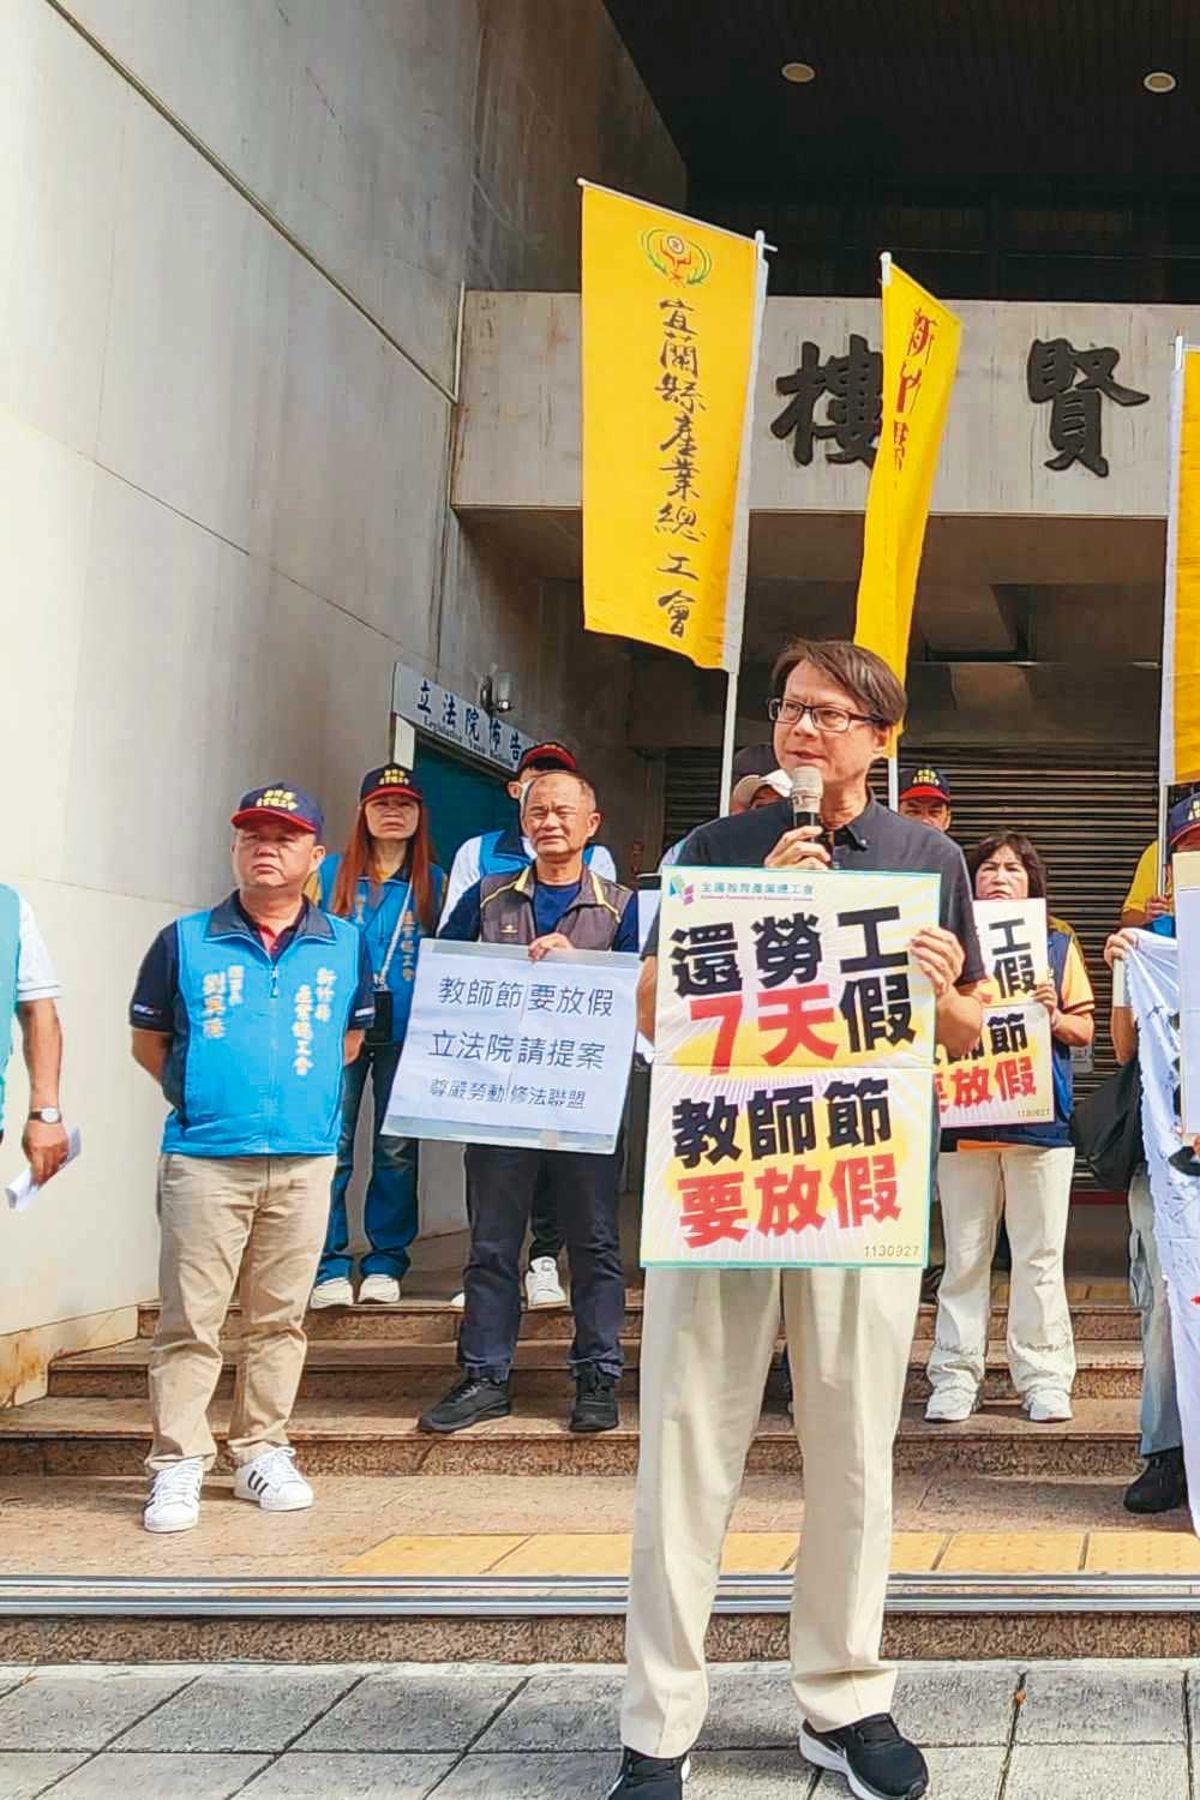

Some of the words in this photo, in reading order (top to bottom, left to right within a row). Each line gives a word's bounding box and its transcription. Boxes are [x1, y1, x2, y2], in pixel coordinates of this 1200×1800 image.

[438, 977, 614, 1017] 教師節要放假
[669, 906, 909, 998] 還勞工
[429, 1029, 606, 1070] 立法院請提案
[689, 976, 918, 1075] 7天假
[671, 1077, 892, 1169] 教師節
[677, 1153, 902, 1250] 要放假
